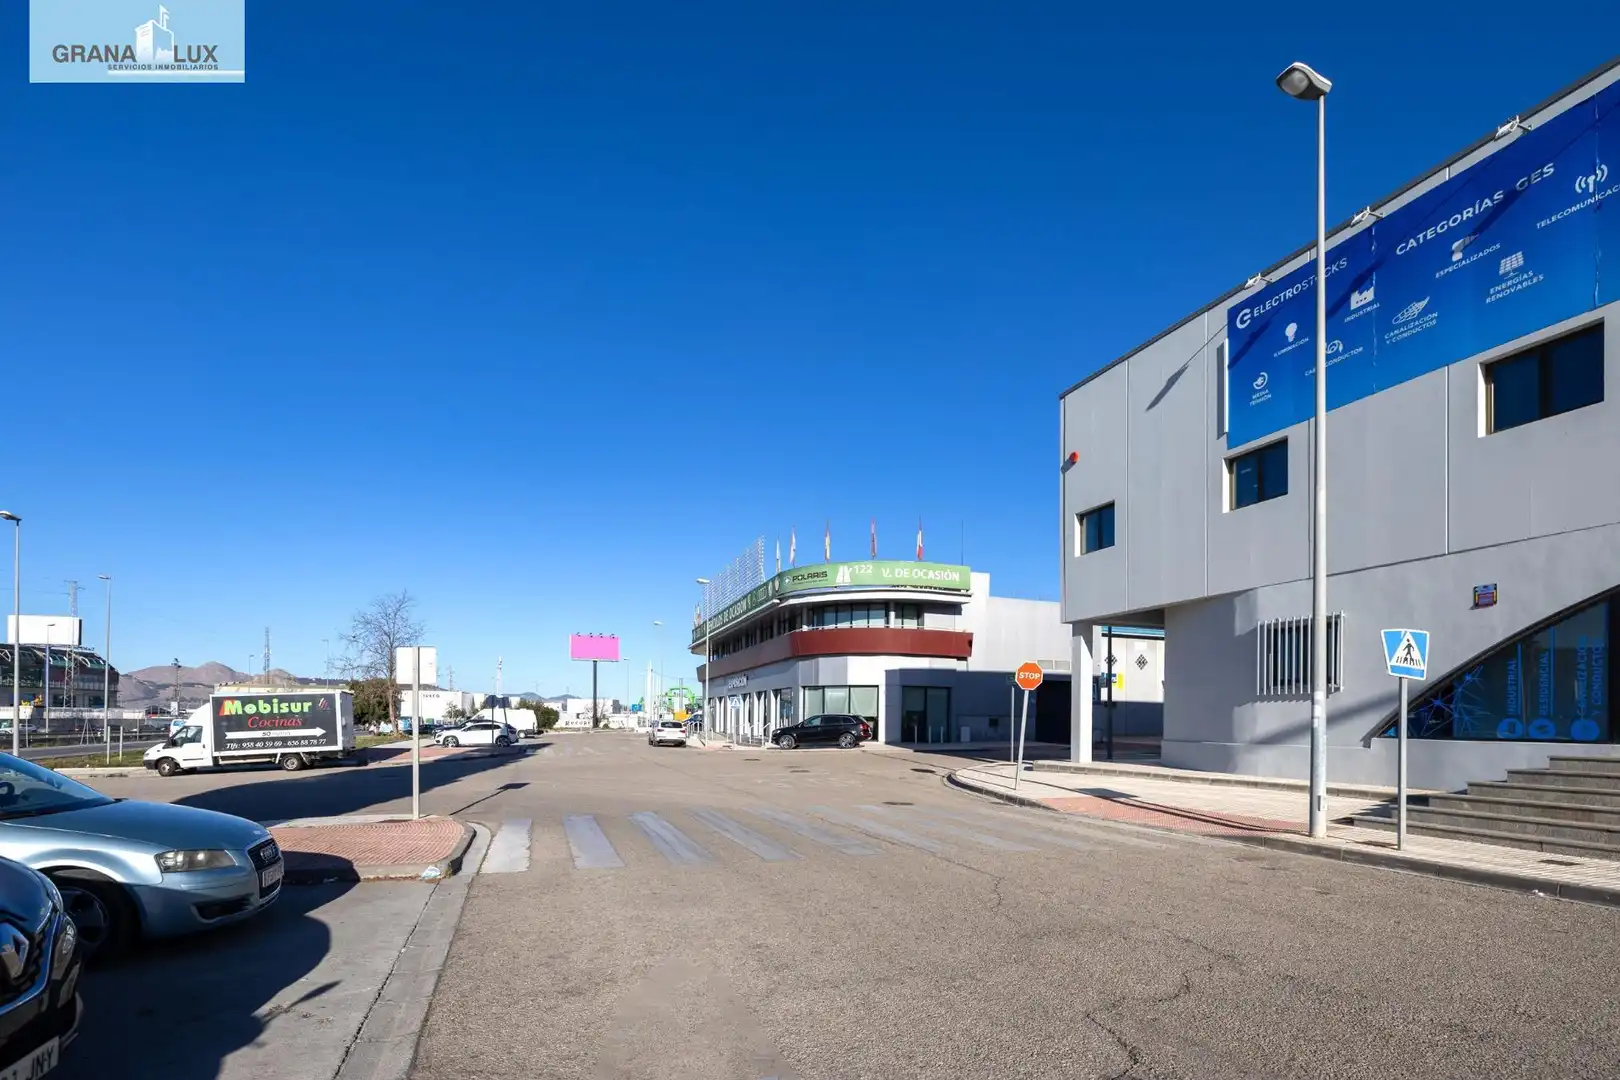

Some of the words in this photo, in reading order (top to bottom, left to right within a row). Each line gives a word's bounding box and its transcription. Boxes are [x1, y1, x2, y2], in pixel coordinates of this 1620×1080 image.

[1396, 190, 1504, 255] CATEGORÍAS
[1515, 162, 1554, 191] GES
[1536, 184, 1620, 229] TELECOMUNICAC
[1435, 242, 1501, 279] ESPECIALIZADOS
[1253, 257, 1348, 318] ELECTROSTCKS
[1486, 273, 1545, 304] RENOVABLES
[792, 571, 828, 581] POLARIS
[855, 564, 873, 574] 122
[895, 568, 910, 578] DE
[1020, 671, 1041, 680] STOP
[1507, 659, 1517, 715] INDUSTRIAL
[219, 698, 312, 716] Mobisur
[247, 715, 303, 728] Cocinas
